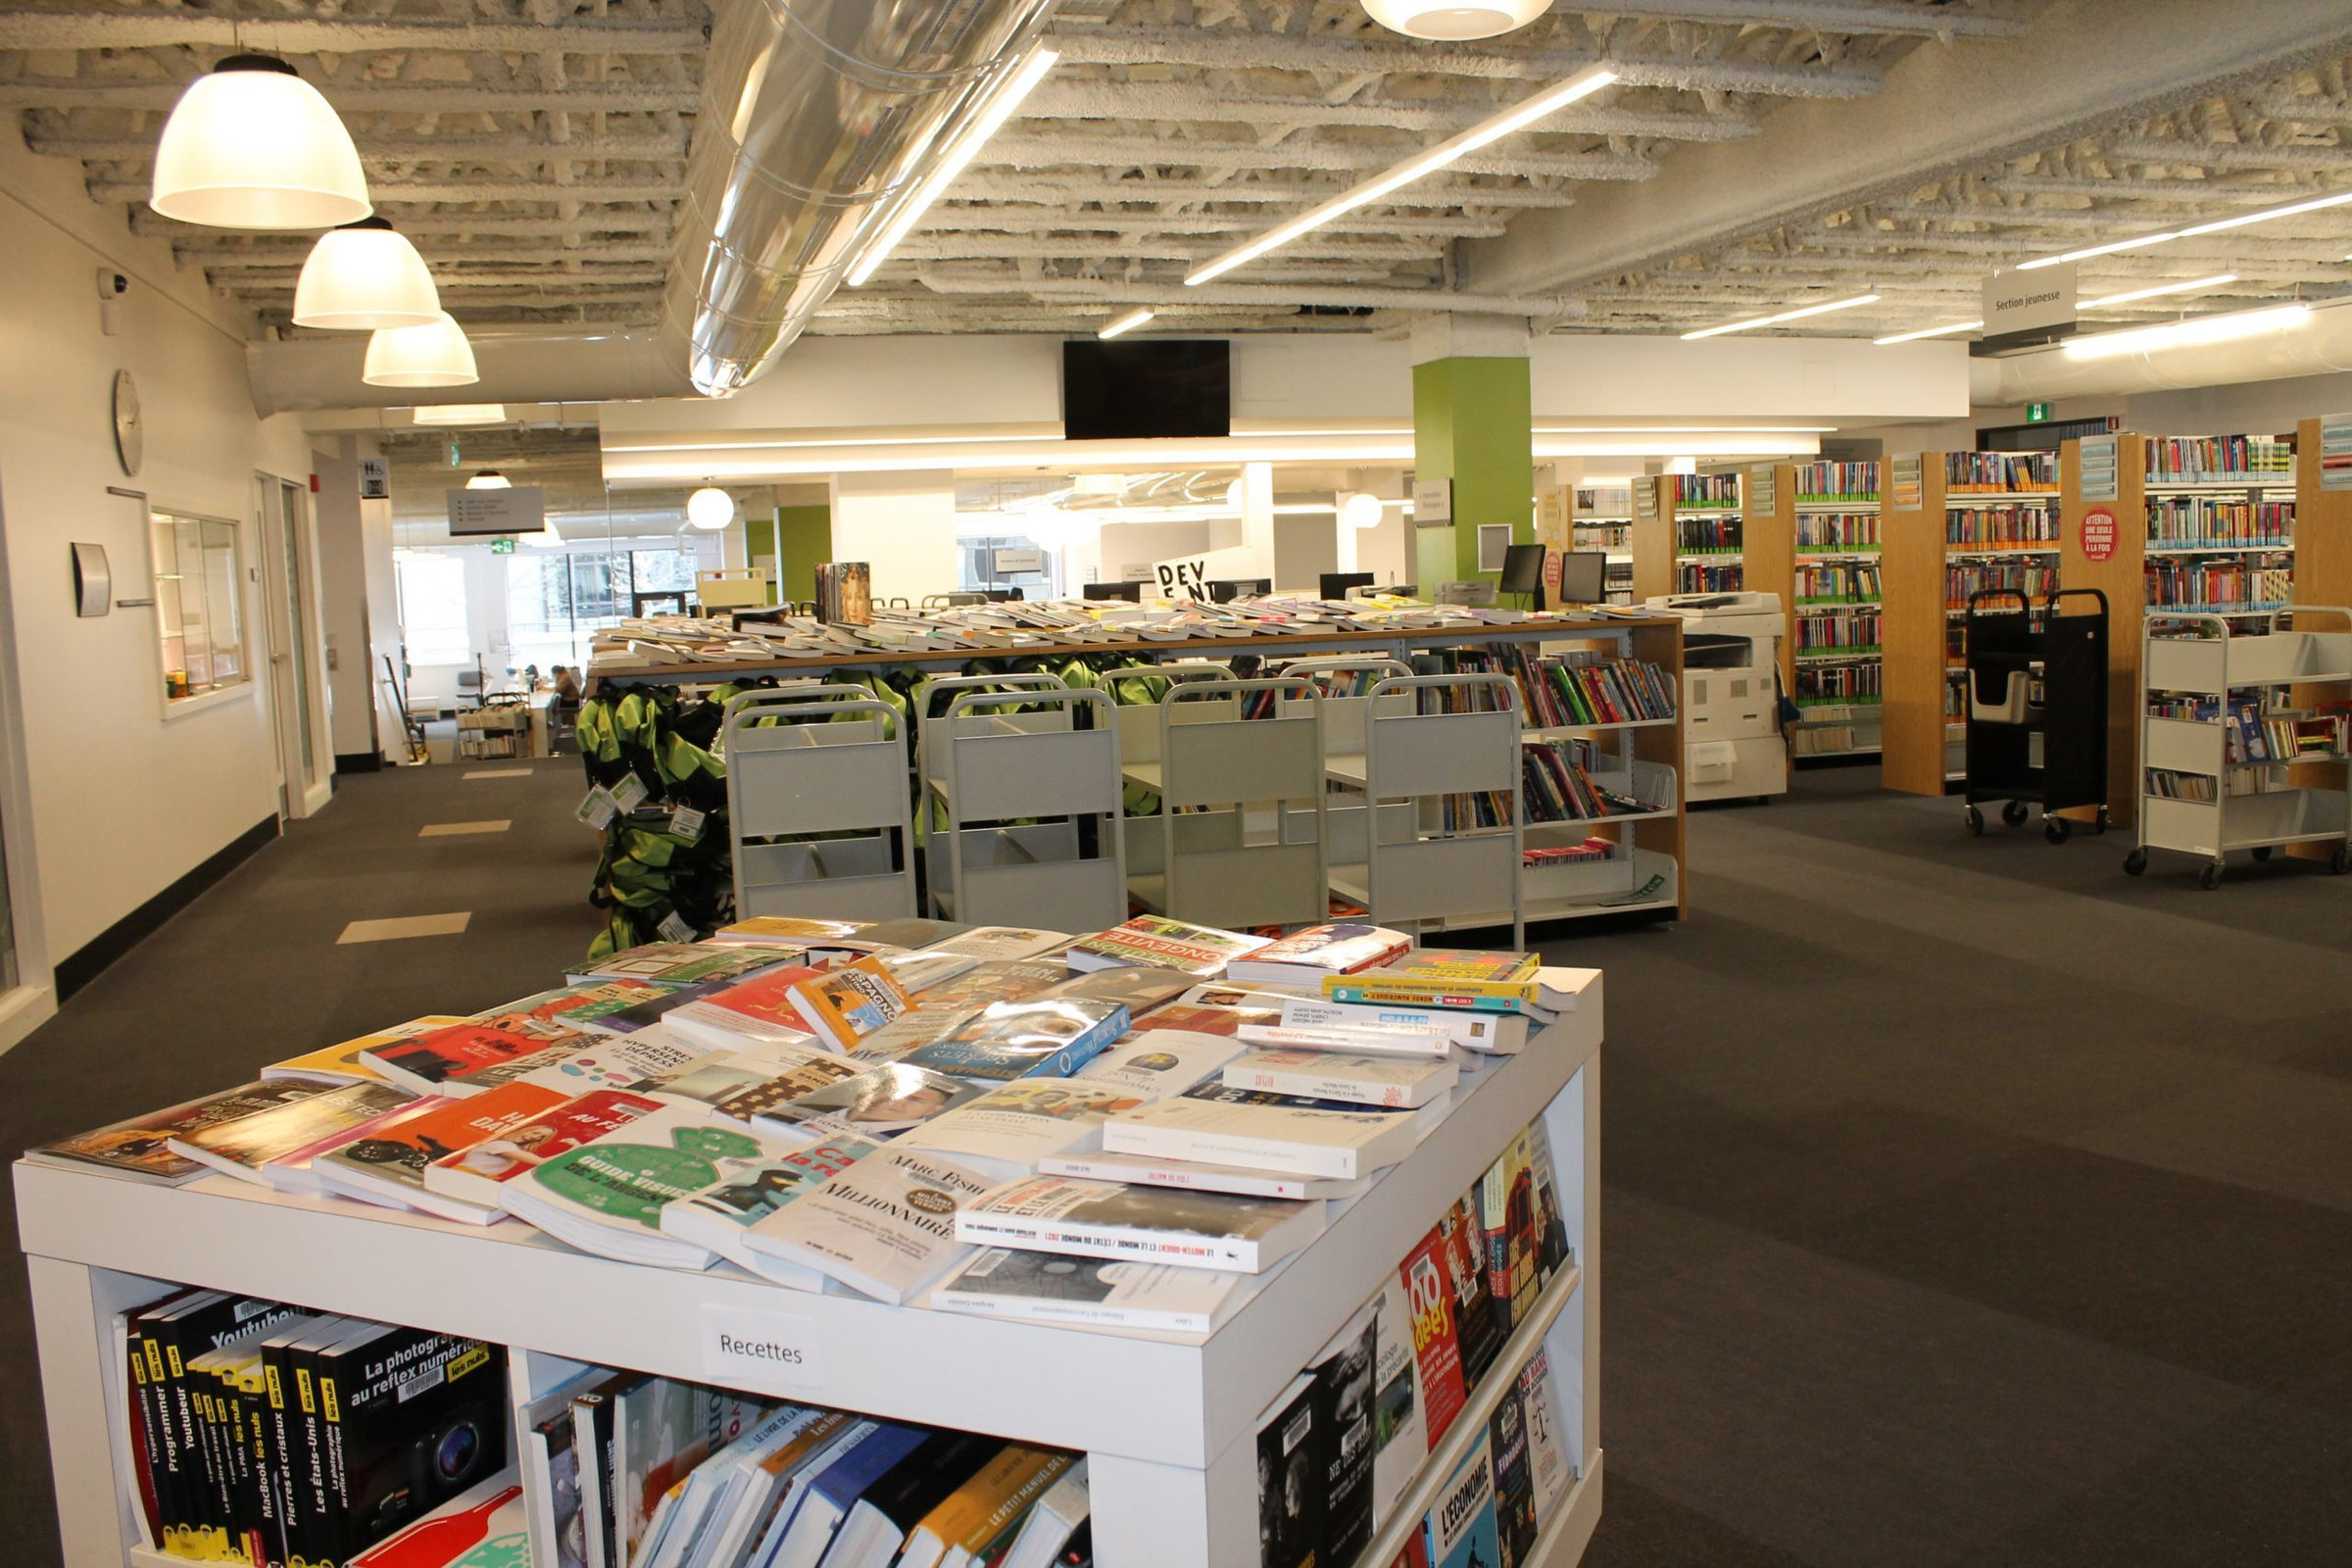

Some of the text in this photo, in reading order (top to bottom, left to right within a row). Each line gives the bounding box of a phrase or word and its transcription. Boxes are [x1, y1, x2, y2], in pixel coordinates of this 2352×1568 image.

[1995, 291, 2061, 311] Section jeunesse
[2085, 514, 2113, 524] ATTENTION
[1157, 561, 1204, 586] DEV
[568, 1113, 595, 1125] AU
[577, 1153, 635, 1183] GUIDE
[890, 1154, 940, 1179] MARC
[819, 1182, 956, 1242] MILLIONNAIRE
[1061, 1234, 1083, 1245] MONDE
[1083, 1236, 1092, 1245] DU
[1117, 1240, 1139, 1251] MONDE
[1140, 1242, 1149, 1250] LE
[1149, 1243, 1156, 1251] ET
[1205, 1249, 1214, 1257] LE
[720, 1334, 804, 1365] Recettes
[366, 1361, 383, 1380] La
[451, 1350, 487, 1376] les nuls
[1530, 1354, 1546, 1379] BANC
[267, 1368, 279, 1391] nuls
[298, 1371, 311, 1394] nuls
[322, 1381, 335, 1404] nuls
[351, 1391, 370, 1407] au
[372, 1366, 416, 1396] reflex
[140, 1388, 159, 1464] L'hypersensibilité
[155, 1385, 178, 1472] Programmer
[176, 1386, 195, 1449] Youtubeur
[760, 1420, 781, 1440] LIVRE
[777, 1414, 790, 1427] DE
[209, 1425, 219, 1452] travail
[229, 1398, 249, 1478] La PMA les nuls
[251, 1411, 272, 1519] MacBook les nuls
[274, 1411, 298, 1527] Pierres et cristaux
[307, 1416, 327, 1514] Les États-Unis
[325, 1425, 339, 1491] La photographie
[333, 1426, 349, 1509] au reflex numérique
[1329, 1459, 1341, 1482] NE
[218, 1464, 229, 1501] Bien-être
[988, 1512, 1003, 1527] LE
[998, 1494, 1022, 1518] PETIT
[1019, 1467, 1052, 1499] MANUEL
[1047, 1458, 1061, 1472] DE
[1442, 1455, 1489, 1536] L'ÉCONOMIE
